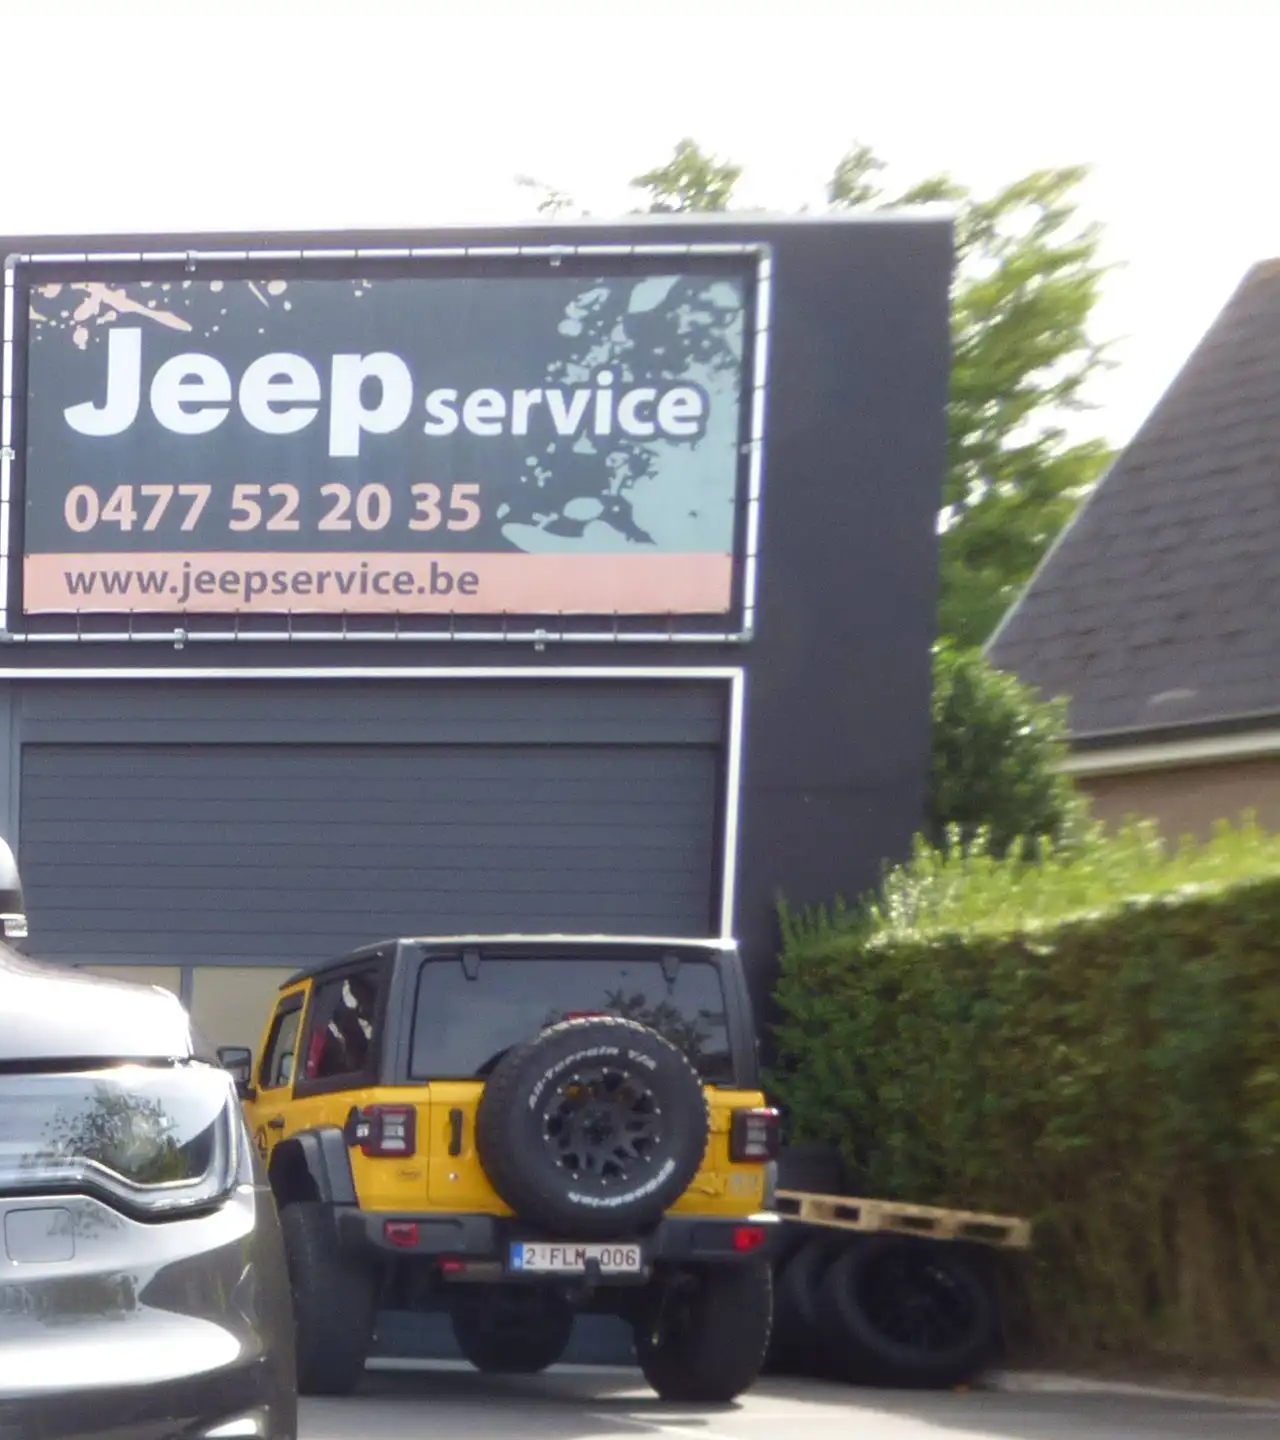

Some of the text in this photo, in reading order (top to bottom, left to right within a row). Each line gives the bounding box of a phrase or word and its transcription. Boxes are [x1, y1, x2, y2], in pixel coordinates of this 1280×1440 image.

[62, 327, 704, 457] Jeep service
[63, 483, 482, 532] 0477 52 20 35
[64, 562, 480, 604] www.jeepservice.be
